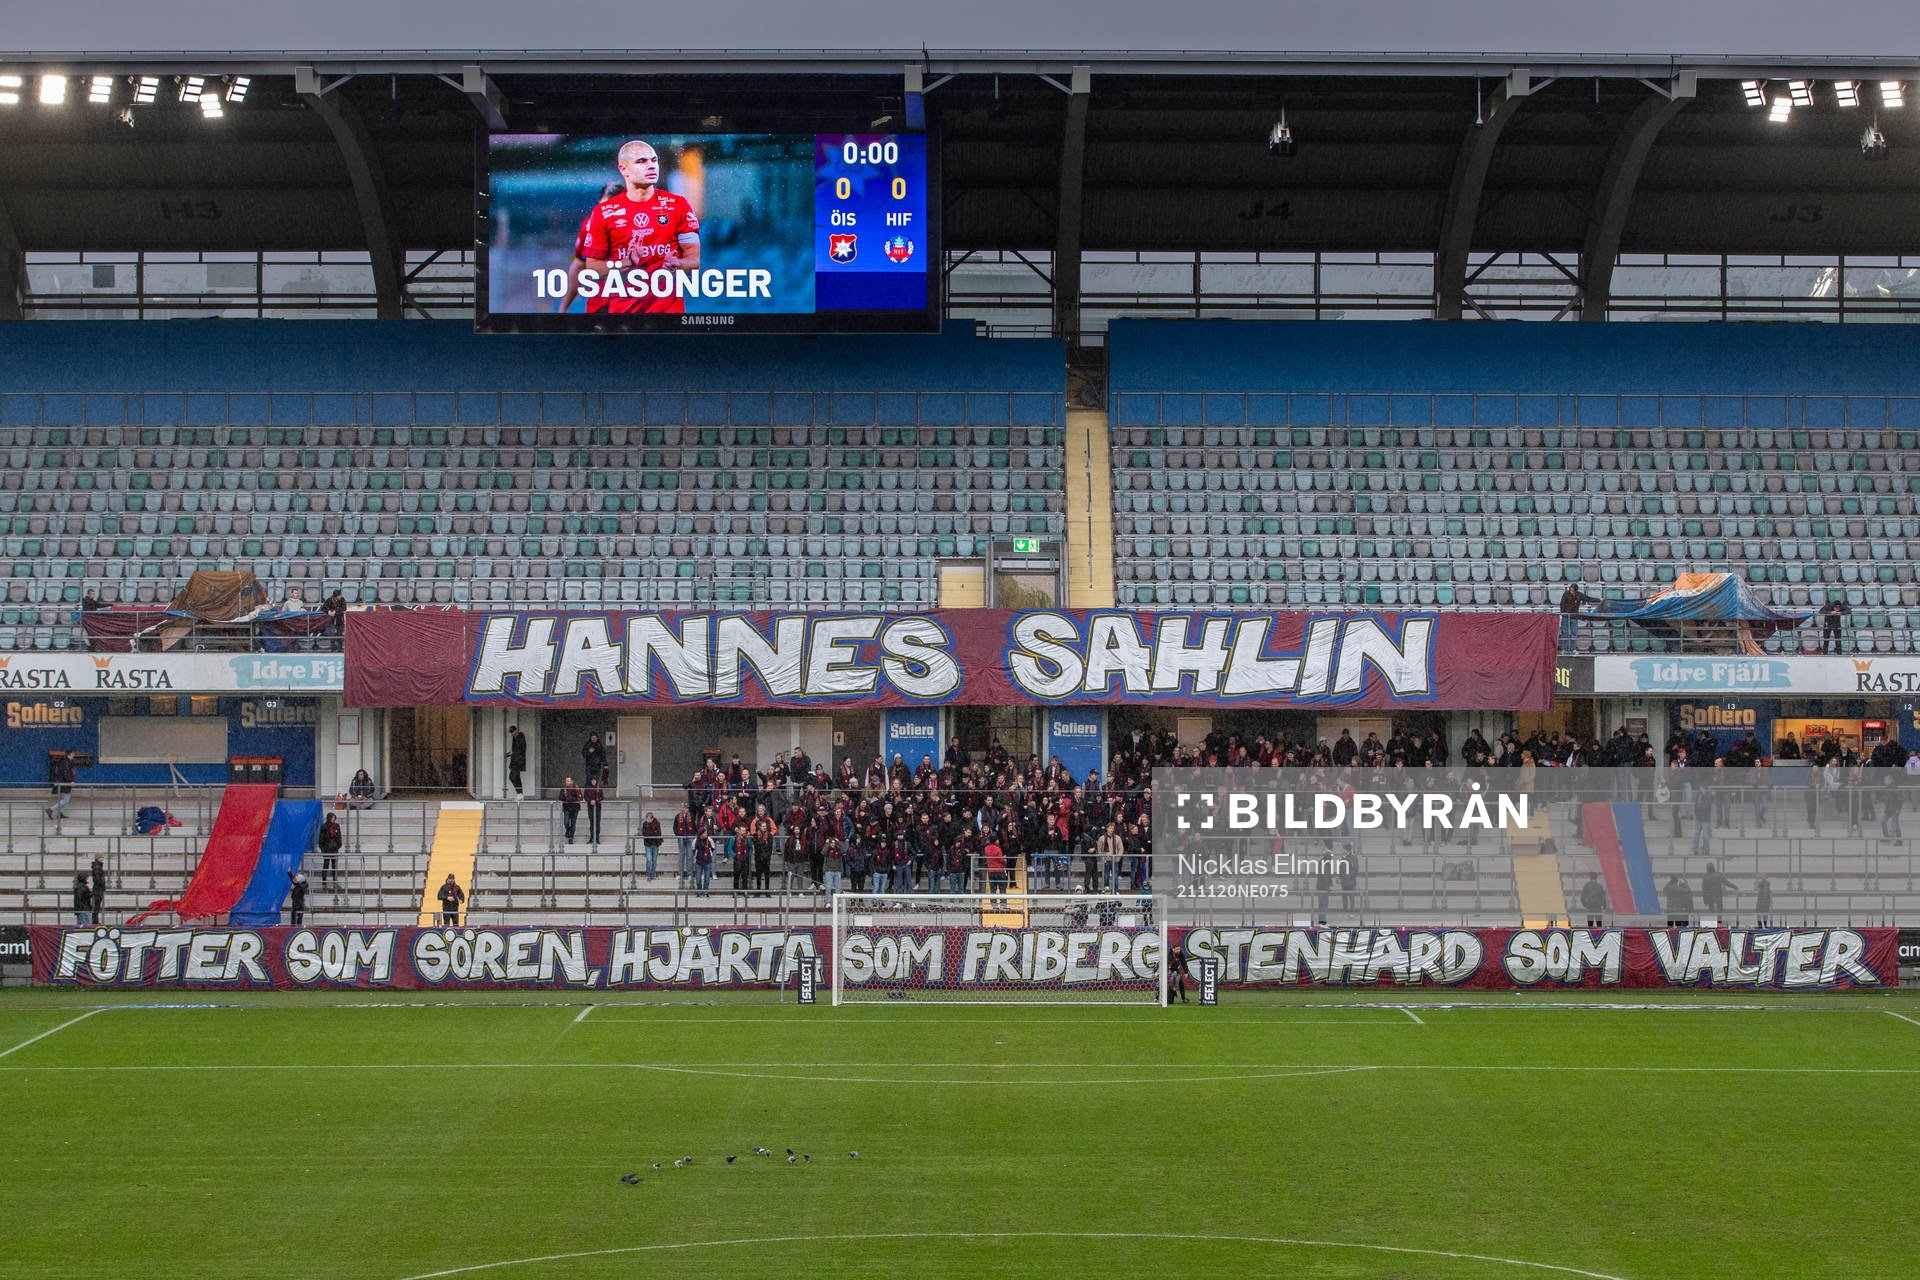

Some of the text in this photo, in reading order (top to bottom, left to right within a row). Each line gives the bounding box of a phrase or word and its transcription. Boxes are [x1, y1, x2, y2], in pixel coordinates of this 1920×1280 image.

[843, 142, 898, 164] 0:00
[836, 177, 906, 199] 0 0
[831, 209, 912, 226] ÖIS HIF
[533, 260, 772, 298] 10 SÄSONGER
[681, 315, 735, 325] SAMSUNG
[470, 613, 1433, 698] HANNES SAHLIN
[95, 669, 173, 689] RASTA
[251, 660, 306, 680] Idre
[1652, 663, 1770, 686] Idre Fjäll
[1856, 672, 1920, 692] RAST
[6, 701, 84, 729] Sofiero
[1680, 704, 1756, 731] Sofiero
[890, 723, 935, 739] Sofiero
[1053, 721, 1097, 737] Sofiero
[53, 926, 1881, 987] FÖTTER SOM SÖREN, HJÄRTA SOM FRIBERG STENHÅRD SOM VALTER
[801, 962, 812, 999] SELECT
[1204, 964, 1215, 1001] SELECT
